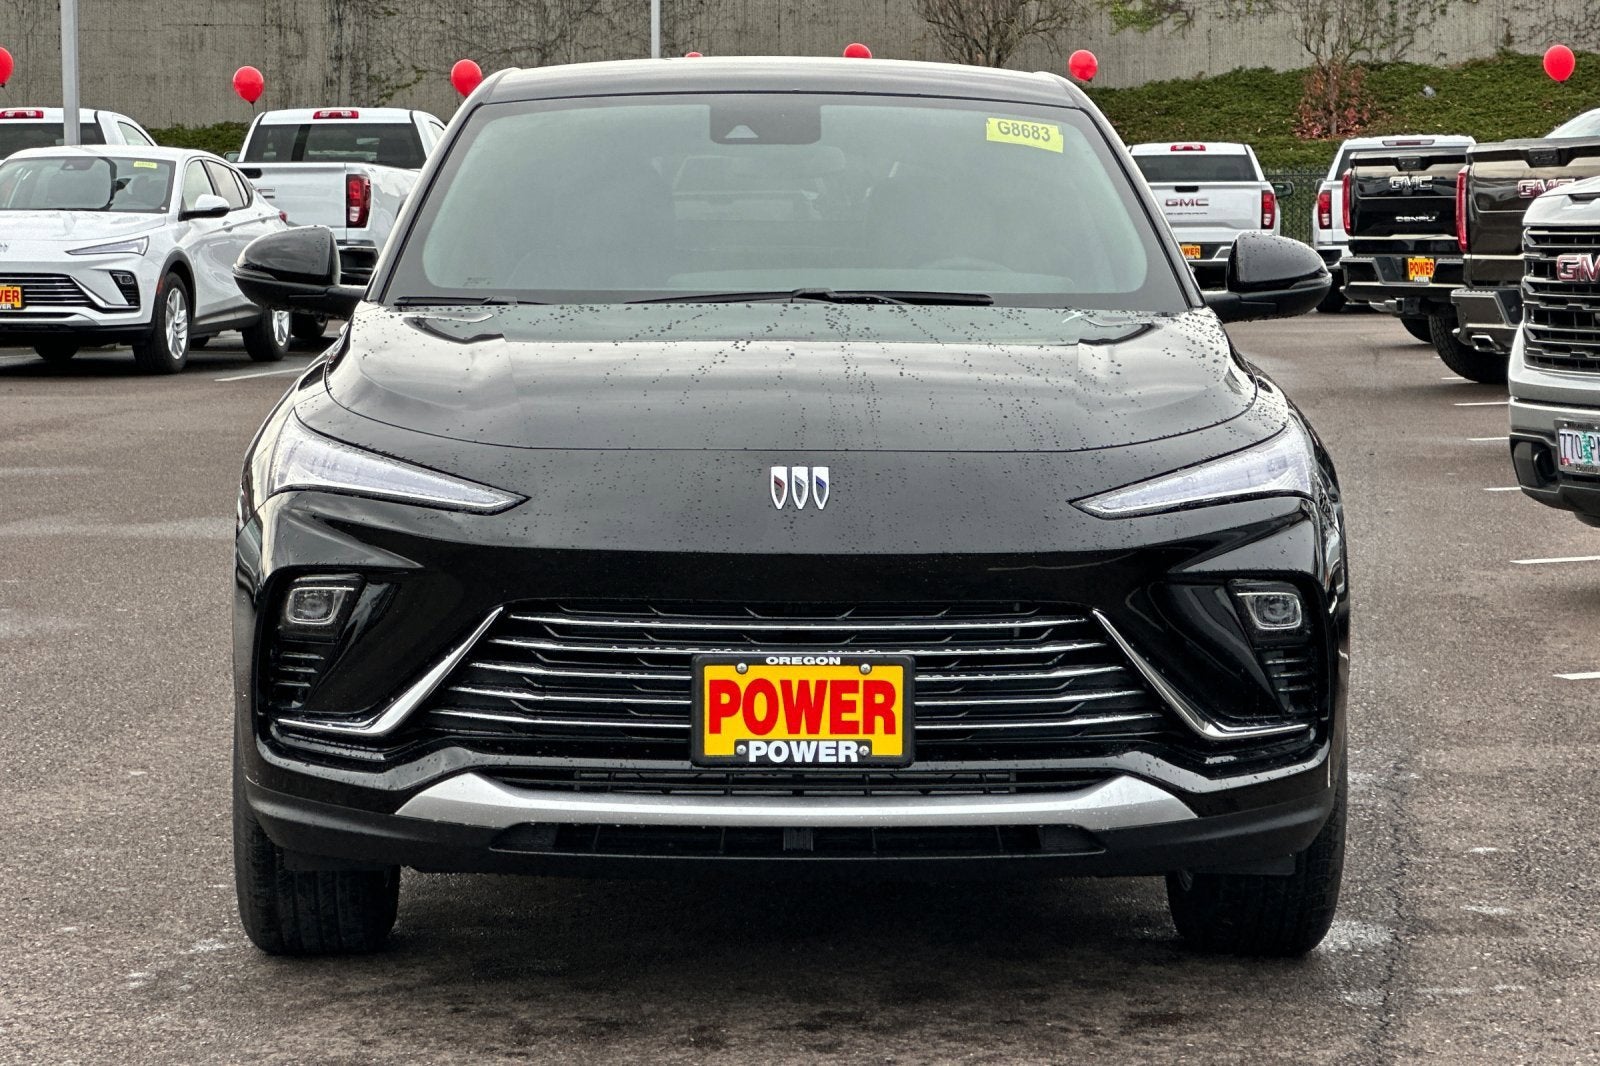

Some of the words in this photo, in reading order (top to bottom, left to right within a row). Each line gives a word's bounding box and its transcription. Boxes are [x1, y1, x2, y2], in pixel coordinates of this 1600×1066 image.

[997, 121, 1051, 142] G8683
[1390, 175, 1433, 190] GMC
[1165, 198, 1209, 207] GMC
[1409, 261, 1434, 275] POWER
[765, 656, 841, 666] OREGON
[708, 678, 897, 736] POWER
[748, 740, 859, 763] POWER
